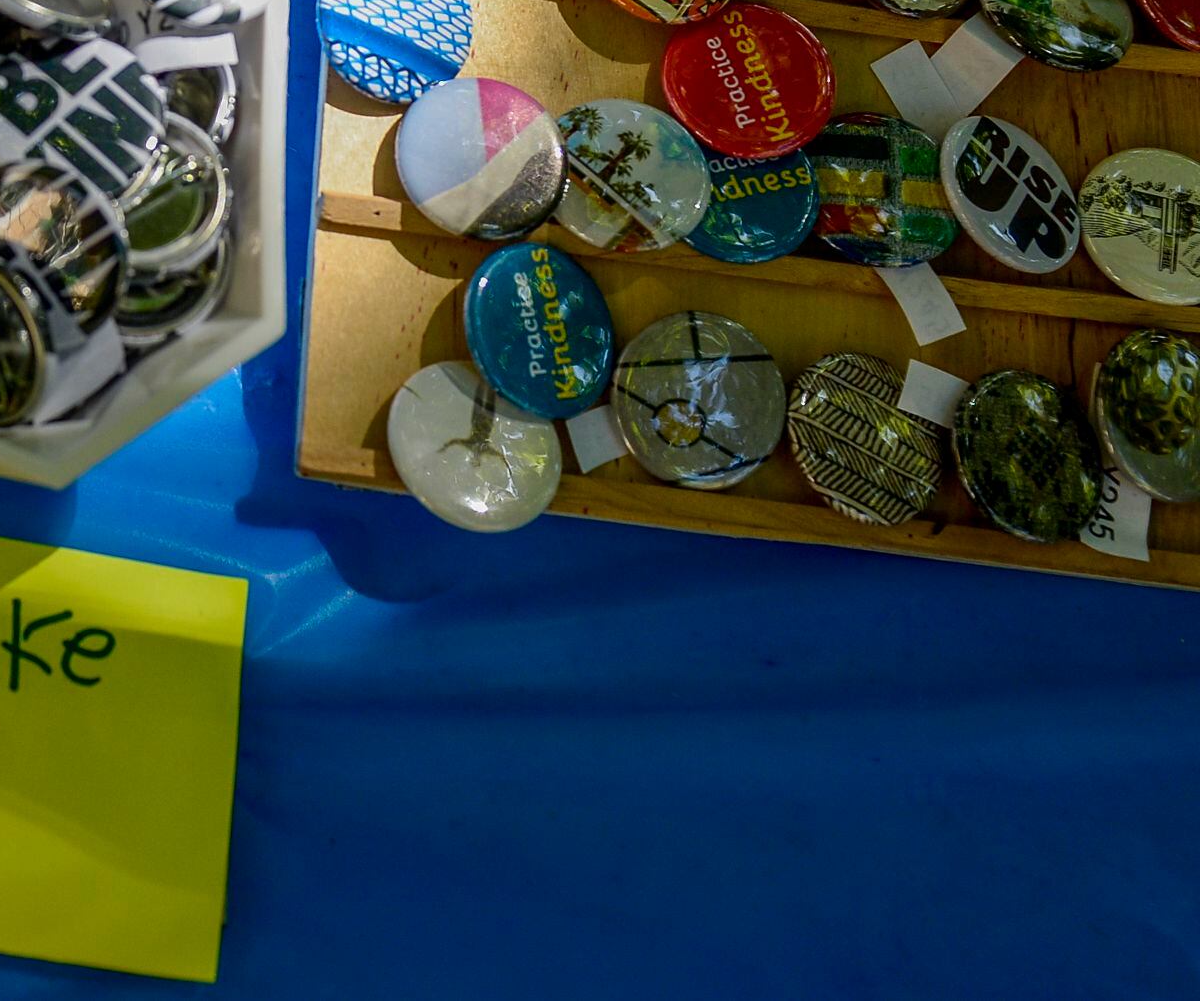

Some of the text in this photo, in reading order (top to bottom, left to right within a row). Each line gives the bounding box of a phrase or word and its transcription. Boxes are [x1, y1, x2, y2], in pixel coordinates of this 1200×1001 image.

[706, 36, 756, 129] Practice
[723, 10, 796, 142] Kindness
[955, 139, 1067, 260] UP
[972, 115, 1080, 235] RISE
[513, 272, 547, 378] Practice
[531, 248, 578, 400] Kindness
